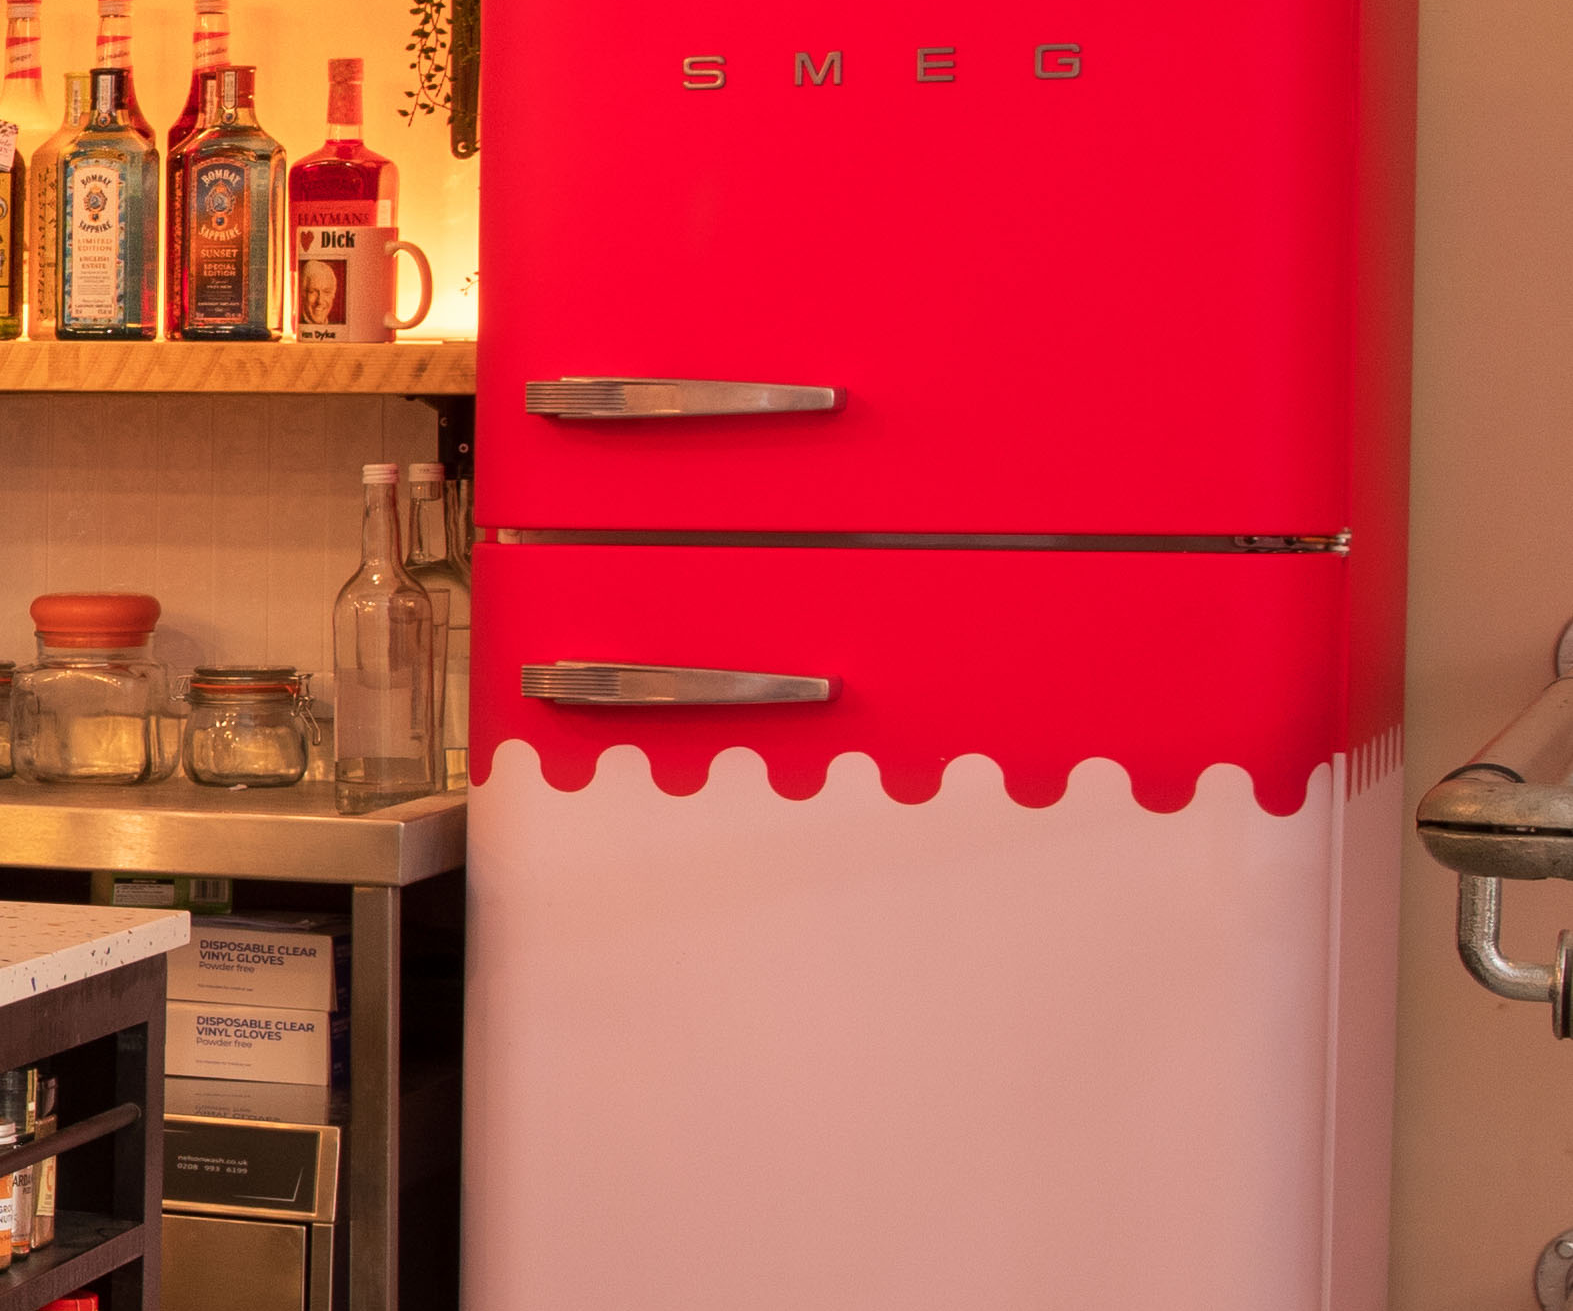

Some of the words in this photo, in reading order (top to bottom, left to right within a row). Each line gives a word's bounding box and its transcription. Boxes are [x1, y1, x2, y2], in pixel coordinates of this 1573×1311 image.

[682, 43, 1082, 90] SMEG
[81, 174, 112, 186] BOMBAY
[201, 169, 240, 187] BOMBAY
[78, 220, 113, 233] SAPPHIRE
[198, 225, 242, 242] SAPPHIRE
[321, 230, 356, 249] Dick
[200, 248, 238, 259] SUNSET
[314, 329, 336, 340] Dyke
[200, 939, 275, 955] DISPOSABLE
[278, 945, 317, 957] CLEAR
[199, 950, 234, 962] VINYL
[236, 953, 284, 965] GLOVES
[199, 961, 234, 972] Powder
[236, 963, 255, 973] free
[196, 1016, 272, 1030] DISPOSABLE
[275, 1021, 315, 1033] CLEAR
[196, 1026, 230, 1037] VINYL
[233, 1029, 282, 1040] GLOVES
[196, 1037, 232, 1048] Powder
[234, 1038, 252, 1049] free
